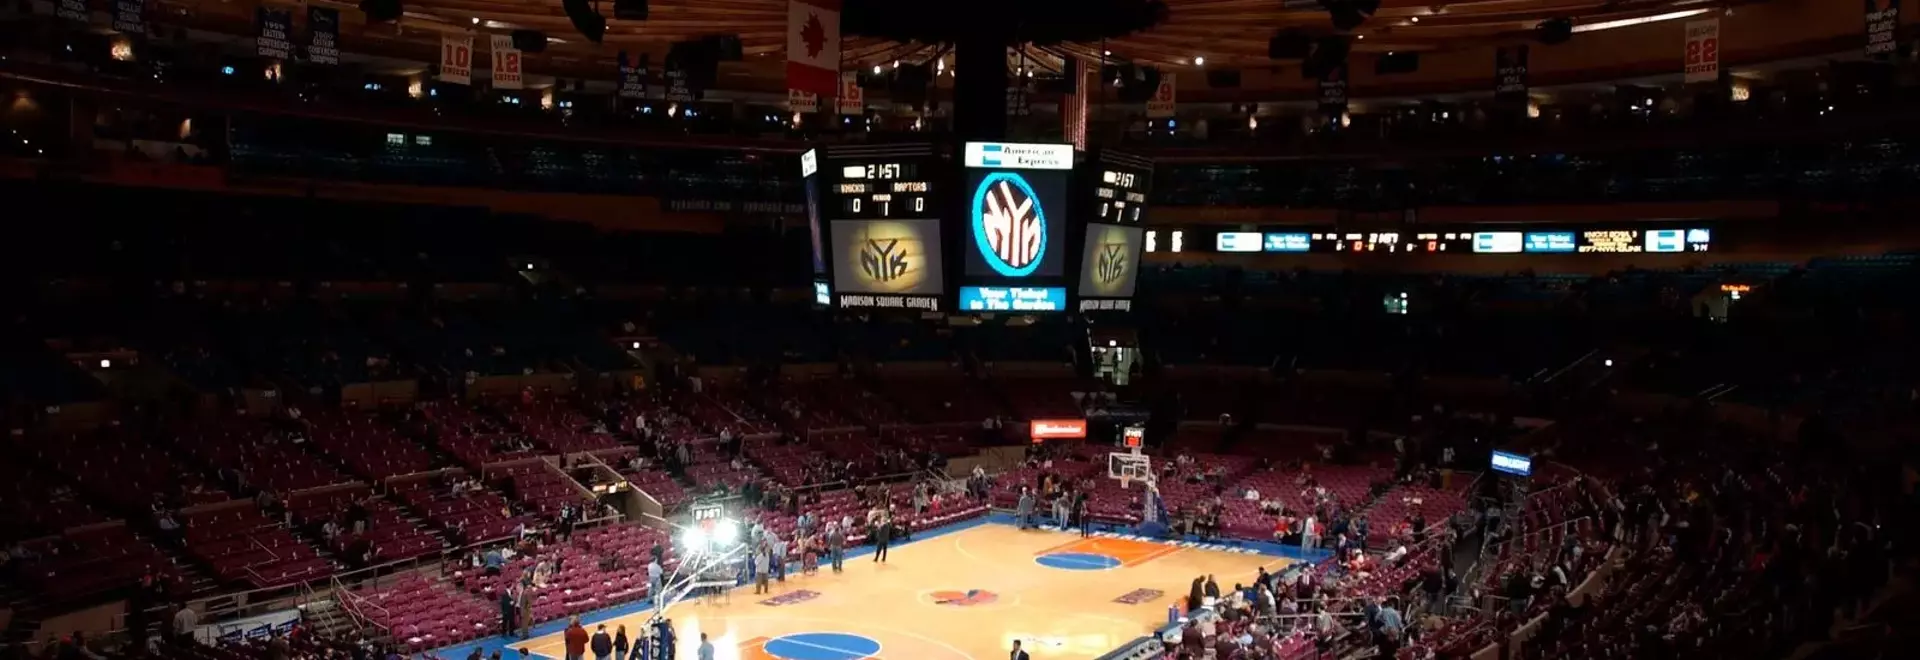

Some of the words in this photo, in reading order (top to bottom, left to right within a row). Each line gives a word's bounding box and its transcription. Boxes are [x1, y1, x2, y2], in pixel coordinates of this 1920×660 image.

[445, 44, 469, 67] 10
[495, 51, 518, 73] 12
[1687, 39, 1717, 64] 22
[893, 181, 927, 192] RAPTORS
[852, 198, 861, 213] 0
[915, 197, 924, 212] 0
[861, 238, 908, 282] NYK
[840, 295, 874, 309] MADISON
[876, 296, 904, 308] SQUARE
[906, 297, 938, 311] GARDEN
